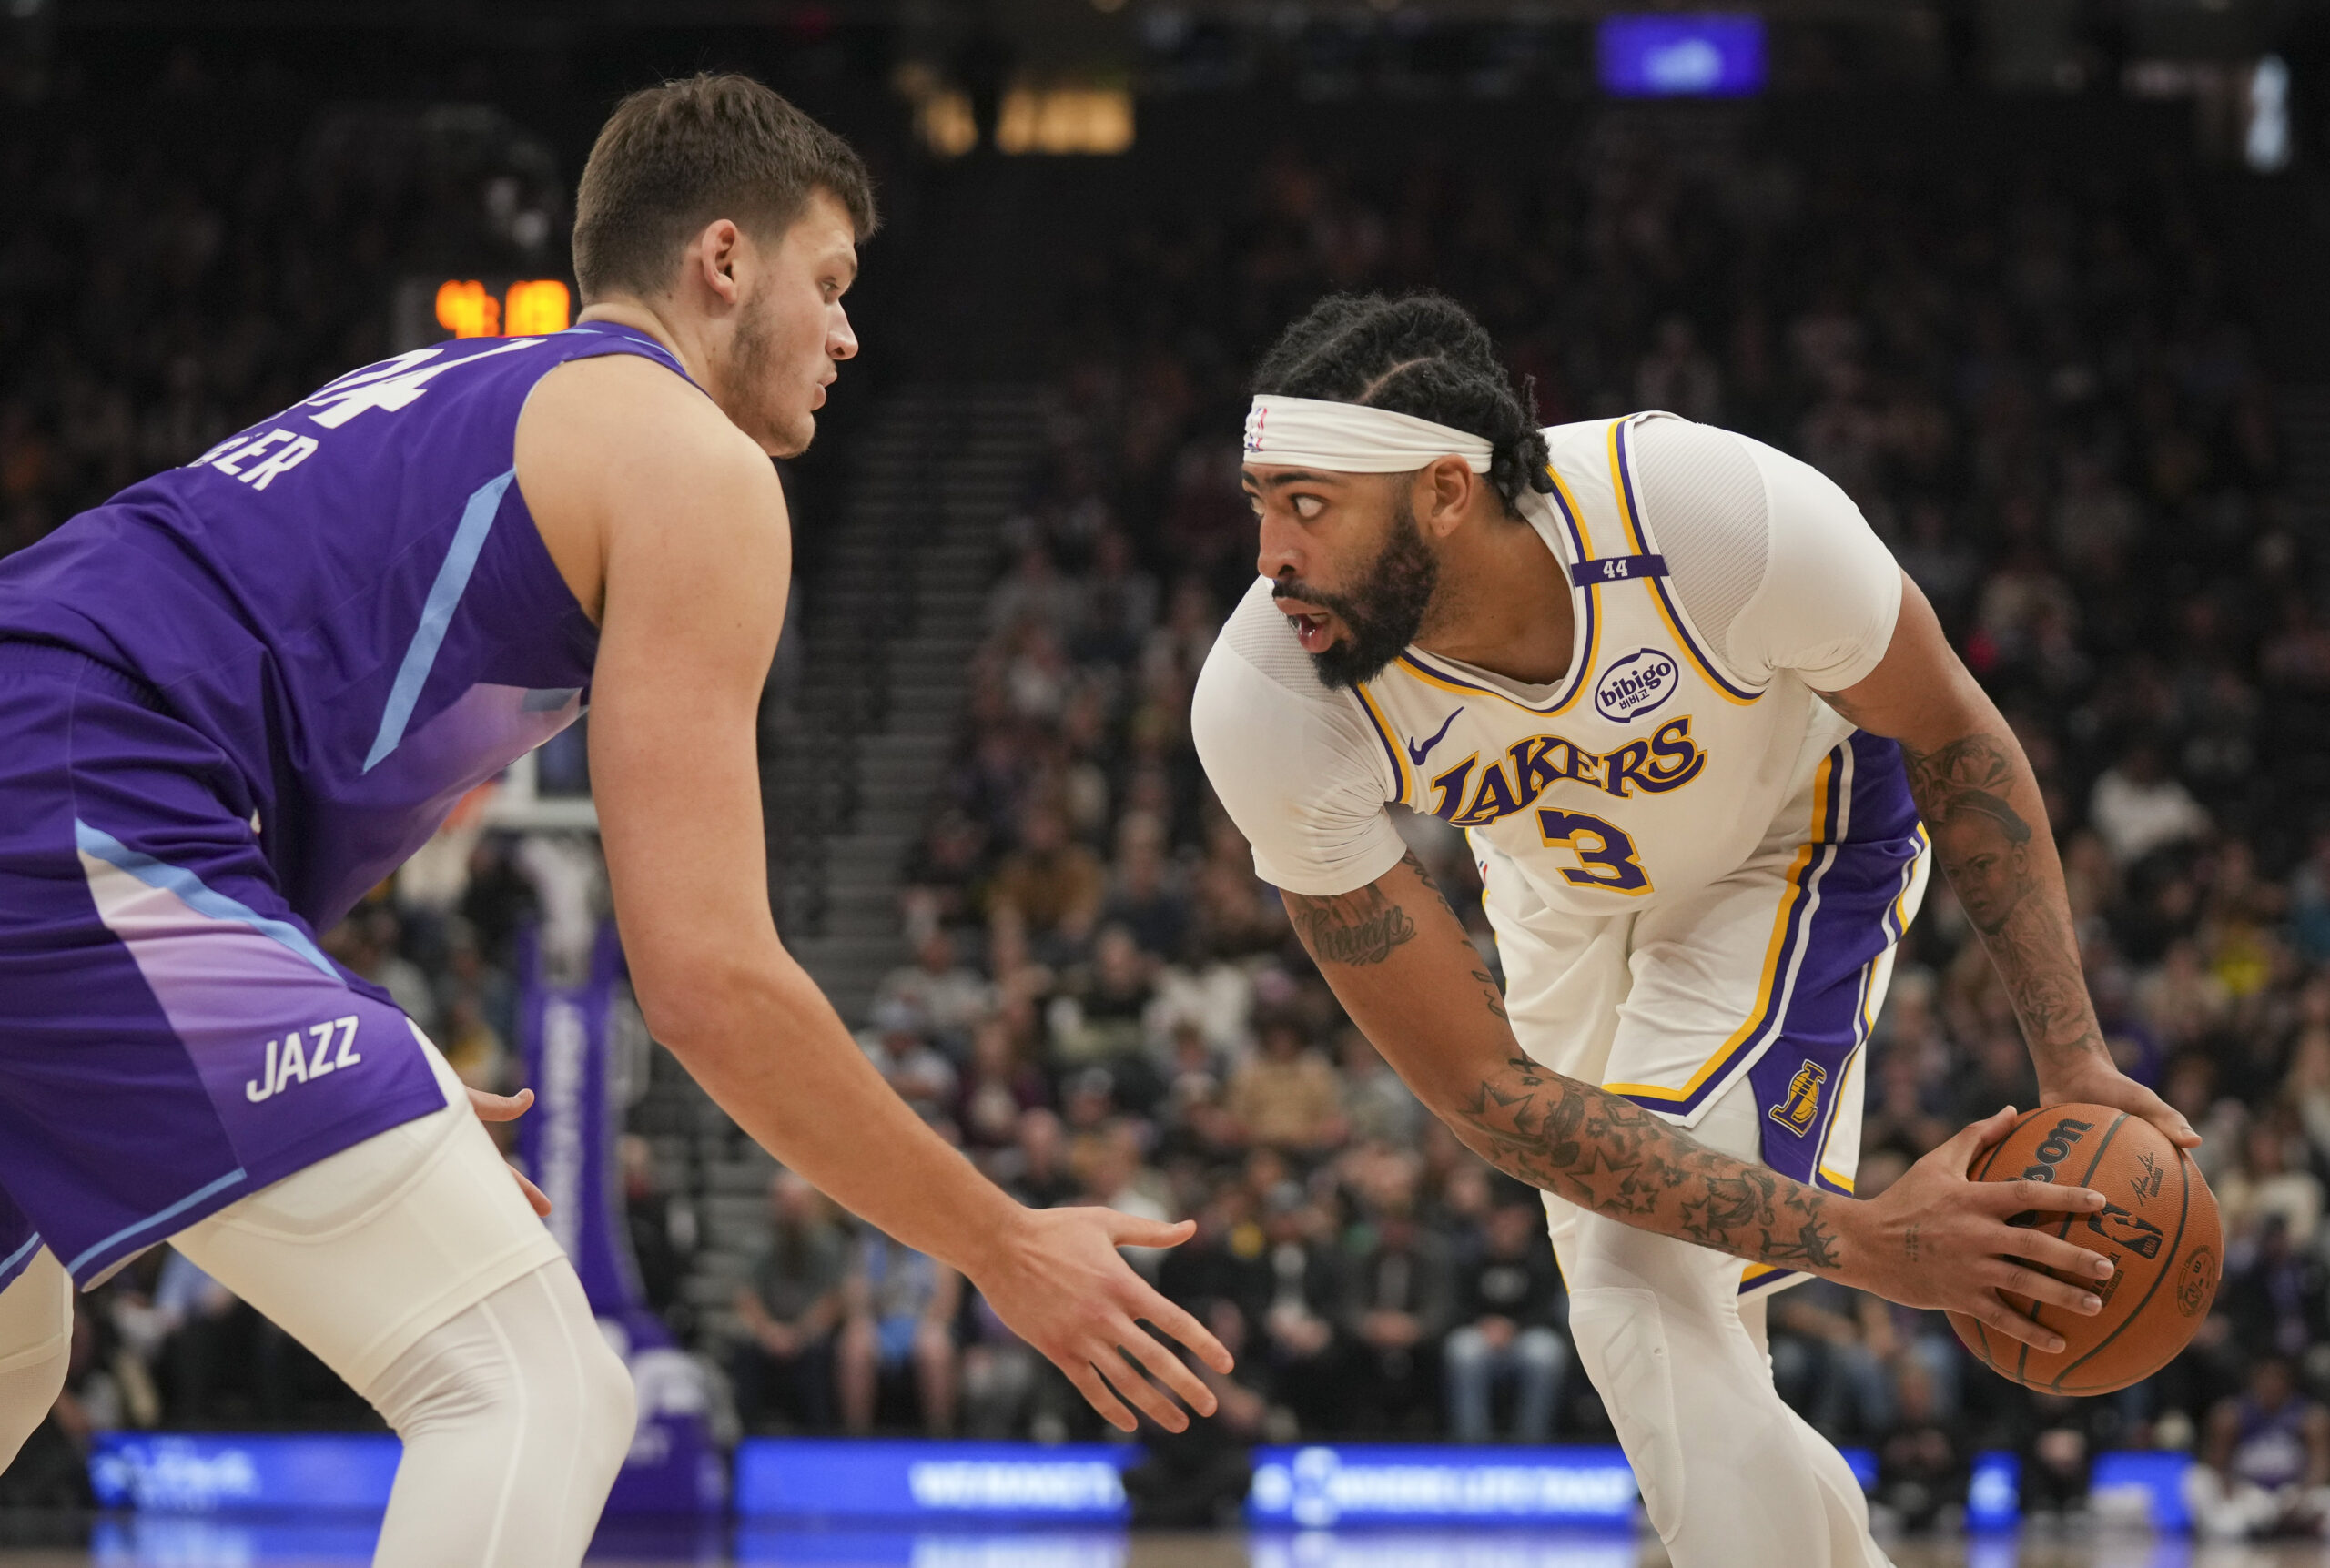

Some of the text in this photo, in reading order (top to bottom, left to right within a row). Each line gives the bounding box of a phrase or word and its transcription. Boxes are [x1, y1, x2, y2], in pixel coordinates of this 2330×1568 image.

[1603, 559, 1628, 579] 44
[1599, 660, 1671, 708] bibigo
[1618, 689, 1651, 712] 비비고
[1429, 714, 1708, 828] LAKERS
[1534, 806, 1655, 897] 3
[246, 1014, 361, 1103] JAZZ
